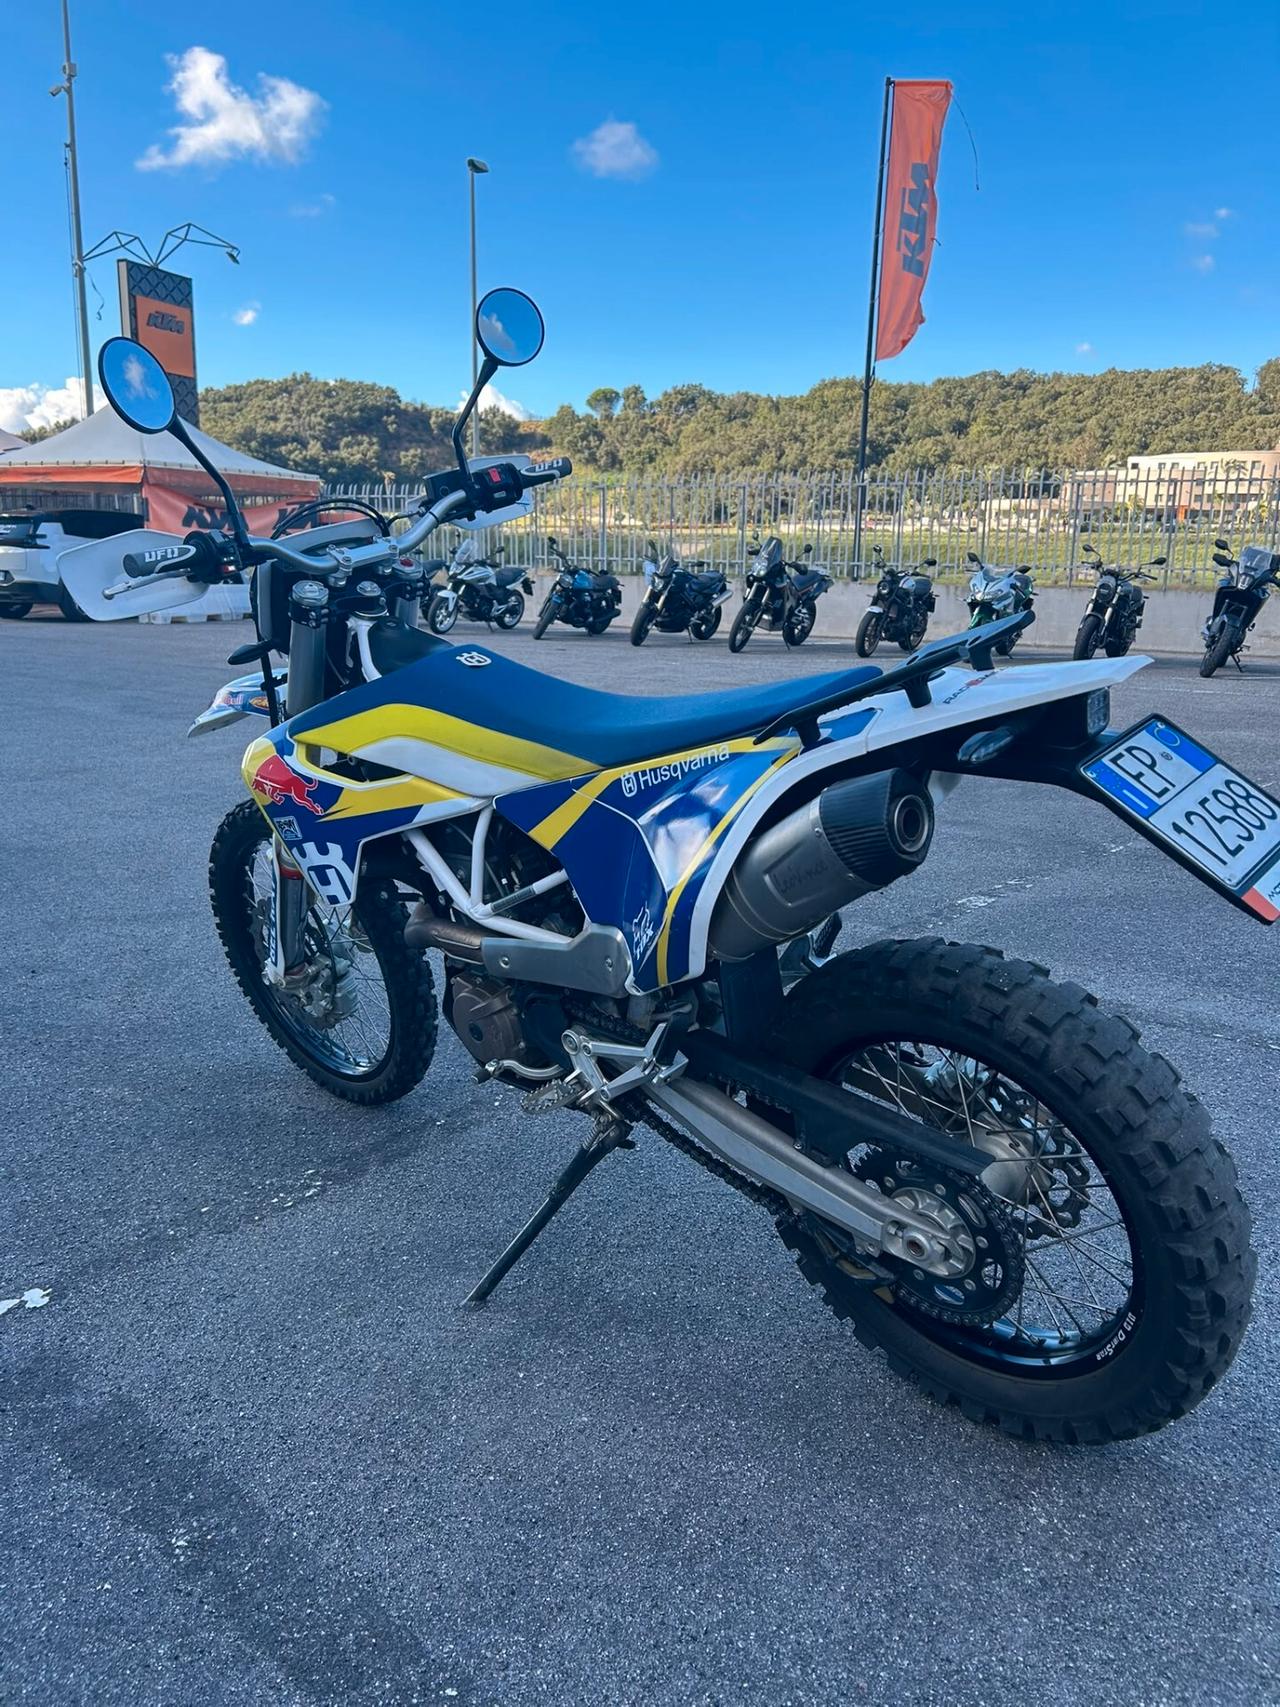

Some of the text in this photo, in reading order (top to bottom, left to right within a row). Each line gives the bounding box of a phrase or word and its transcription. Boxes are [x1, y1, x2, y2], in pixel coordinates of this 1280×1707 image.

[897, 162, 929, 278] KTM
[146, 311, 185, 335] KTM
[535, 459, 563, 472] UFO
[144, 547, 179, 562] UFO
[638, 743, 730, 790] Husqvarna
[1108, 745, 1176, 799] EP
[1171, 779, 1278, 866] 12588
